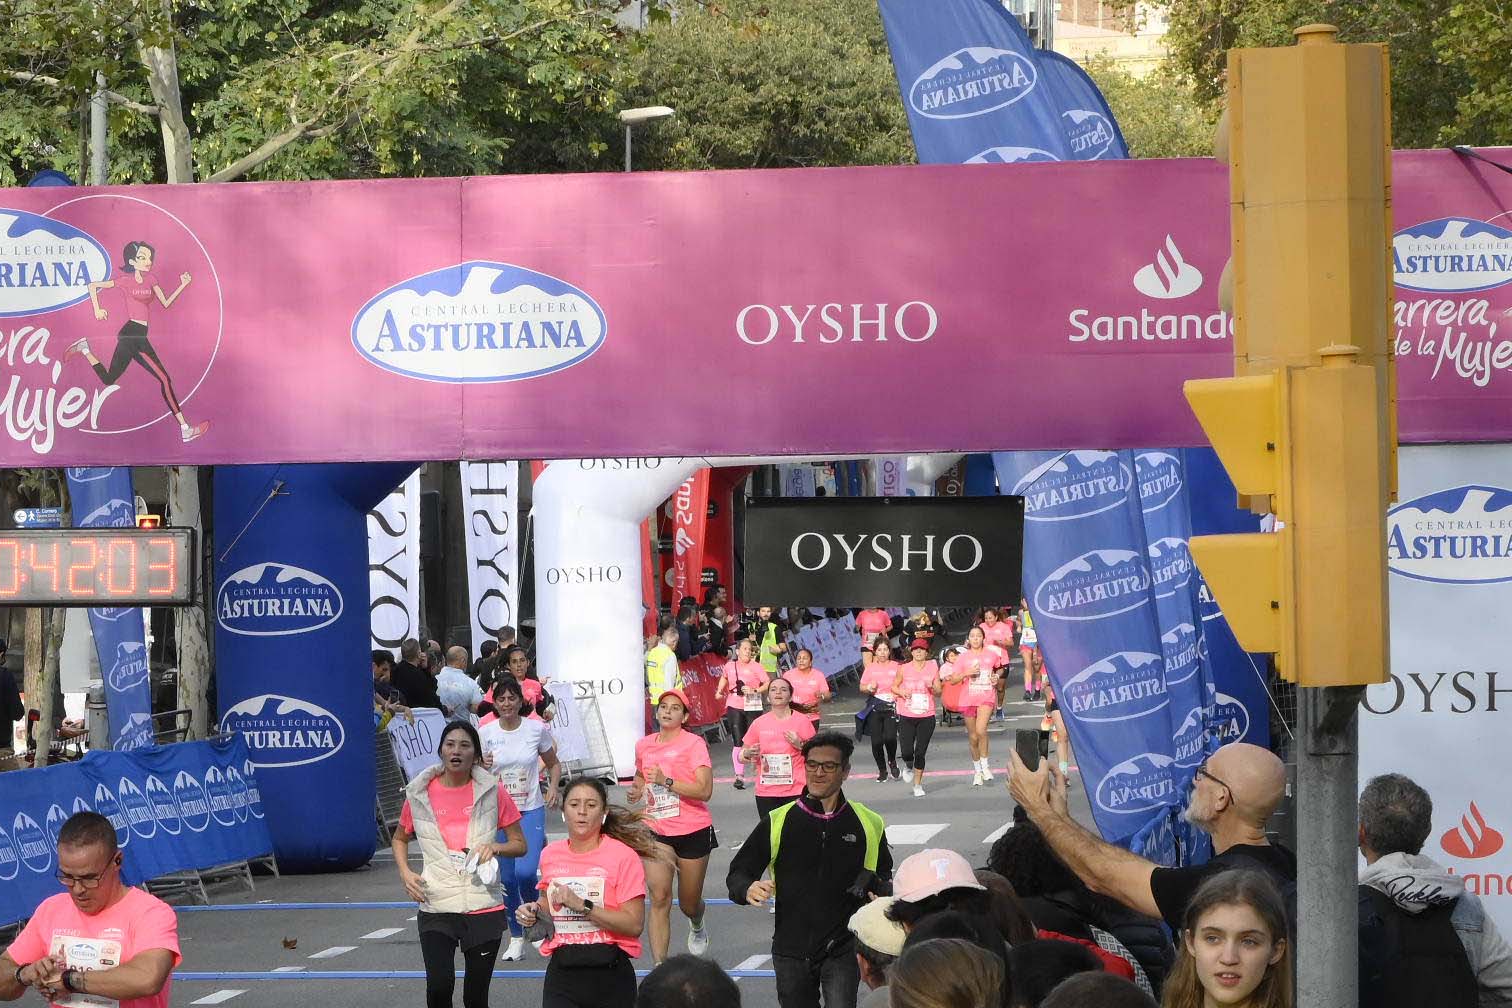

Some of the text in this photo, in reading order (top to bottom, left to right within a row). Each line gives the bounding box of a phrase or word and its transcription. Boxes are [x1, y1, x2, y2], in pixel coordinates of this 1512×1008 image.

[14, 244, 87, 257] LECHERA
[1408, 242, 1512, 251] CENTRAL LECHER
[411, 302, 579, 317] CENTRAL LECHERA
[736, 301, 938, 345] OYSHO
[1393, 299, 1489, 327] arrera
[372, 308, 587, 353] ASTURIANA
[1068, 309, 1236, 342] Santand
[1417, 329, 1435, 356] la
[1431, 322, 1512, 387] Muje
[1415, 521, 1483, 530] CENTRAL
[790, 532, 983, 573] OYSHO
[1388, 524, 1512, 559] ASTURIA
[546, 565, 622, 585] OYSHO
[234, 587, 329, 596] CENTRAL LECHERA
[220, 592, 334, 619] ASTURIANA
[1361, 671, 1512, 714] OYSH
[235, 719, 330, 728] CENTRAL LECHERA
